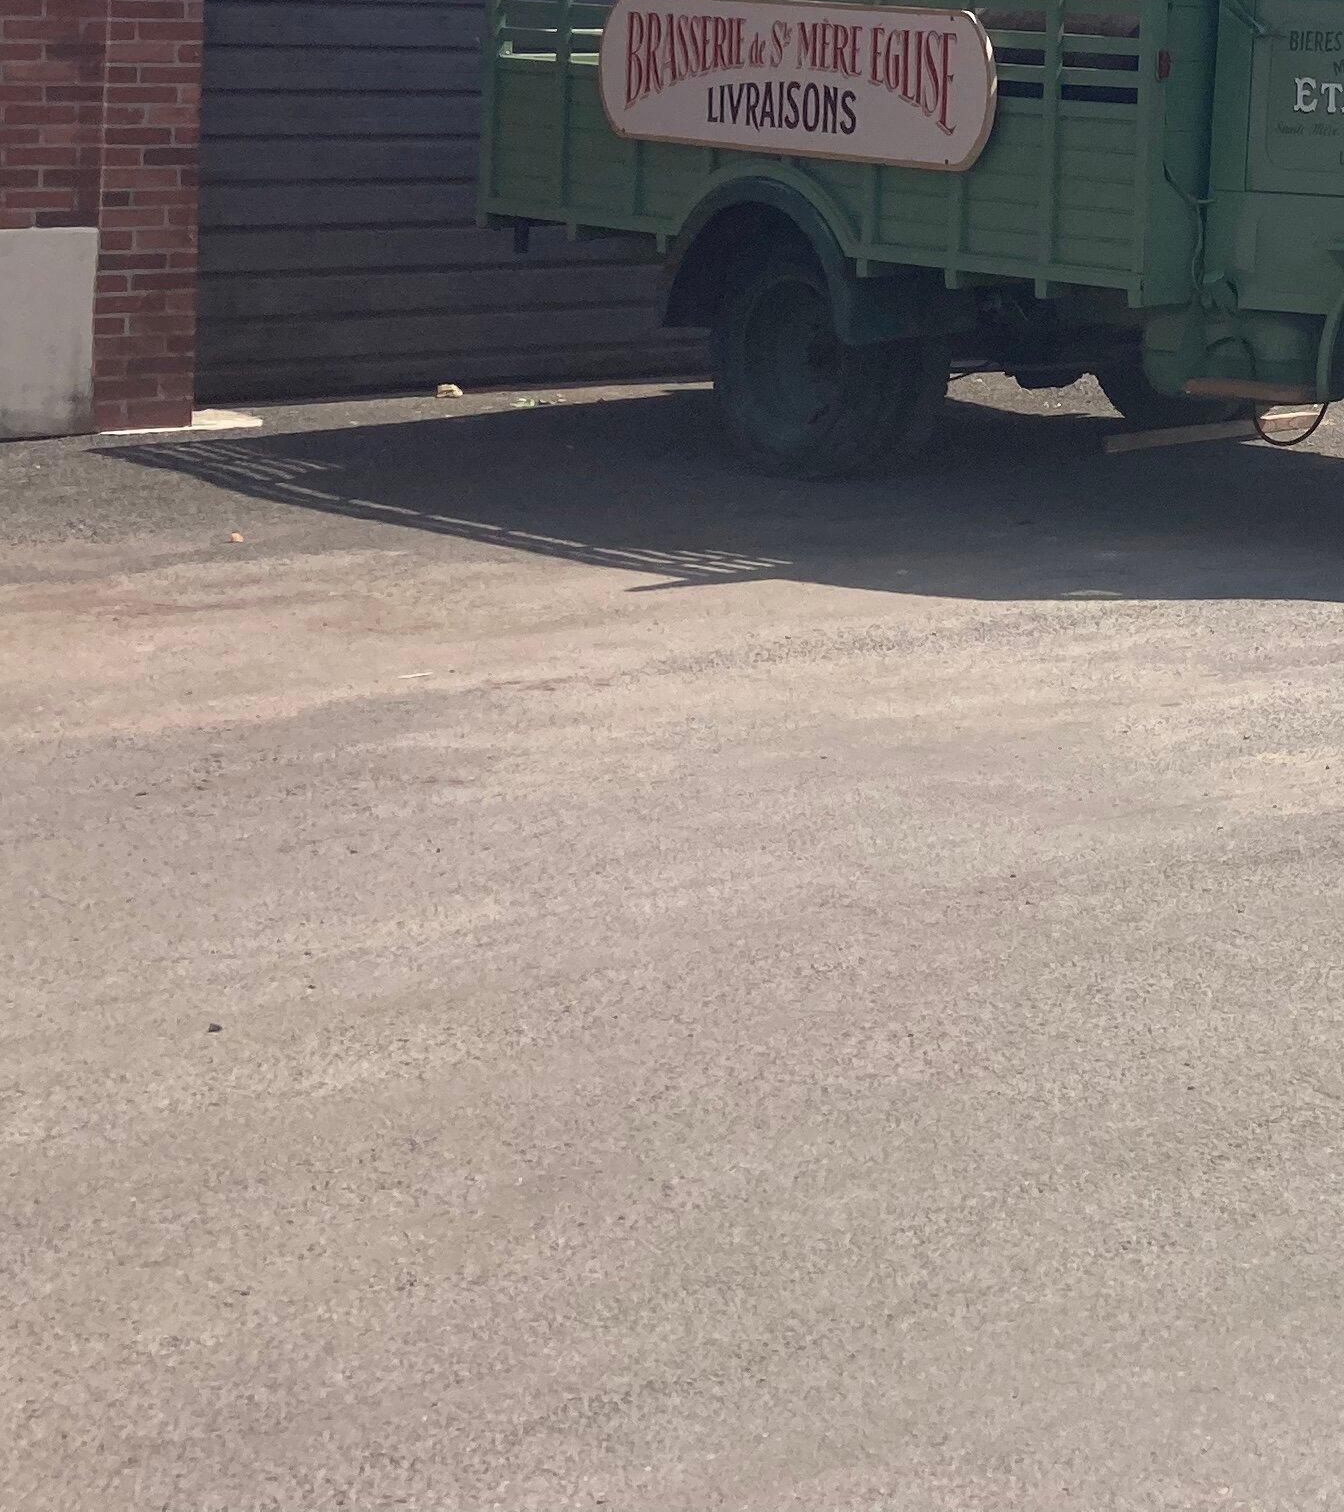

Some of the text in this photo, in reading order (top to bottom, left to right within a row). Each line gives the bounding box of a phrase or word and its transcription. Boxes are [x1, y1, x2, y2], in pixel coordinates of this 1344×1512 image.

[625, 11, 747, 111] BRASSERIE
[750, 31, 767, 68] de
[868, 23, 957, 136] ÉGLISE
[707, 80, 857, 136] LIVRAISONS
